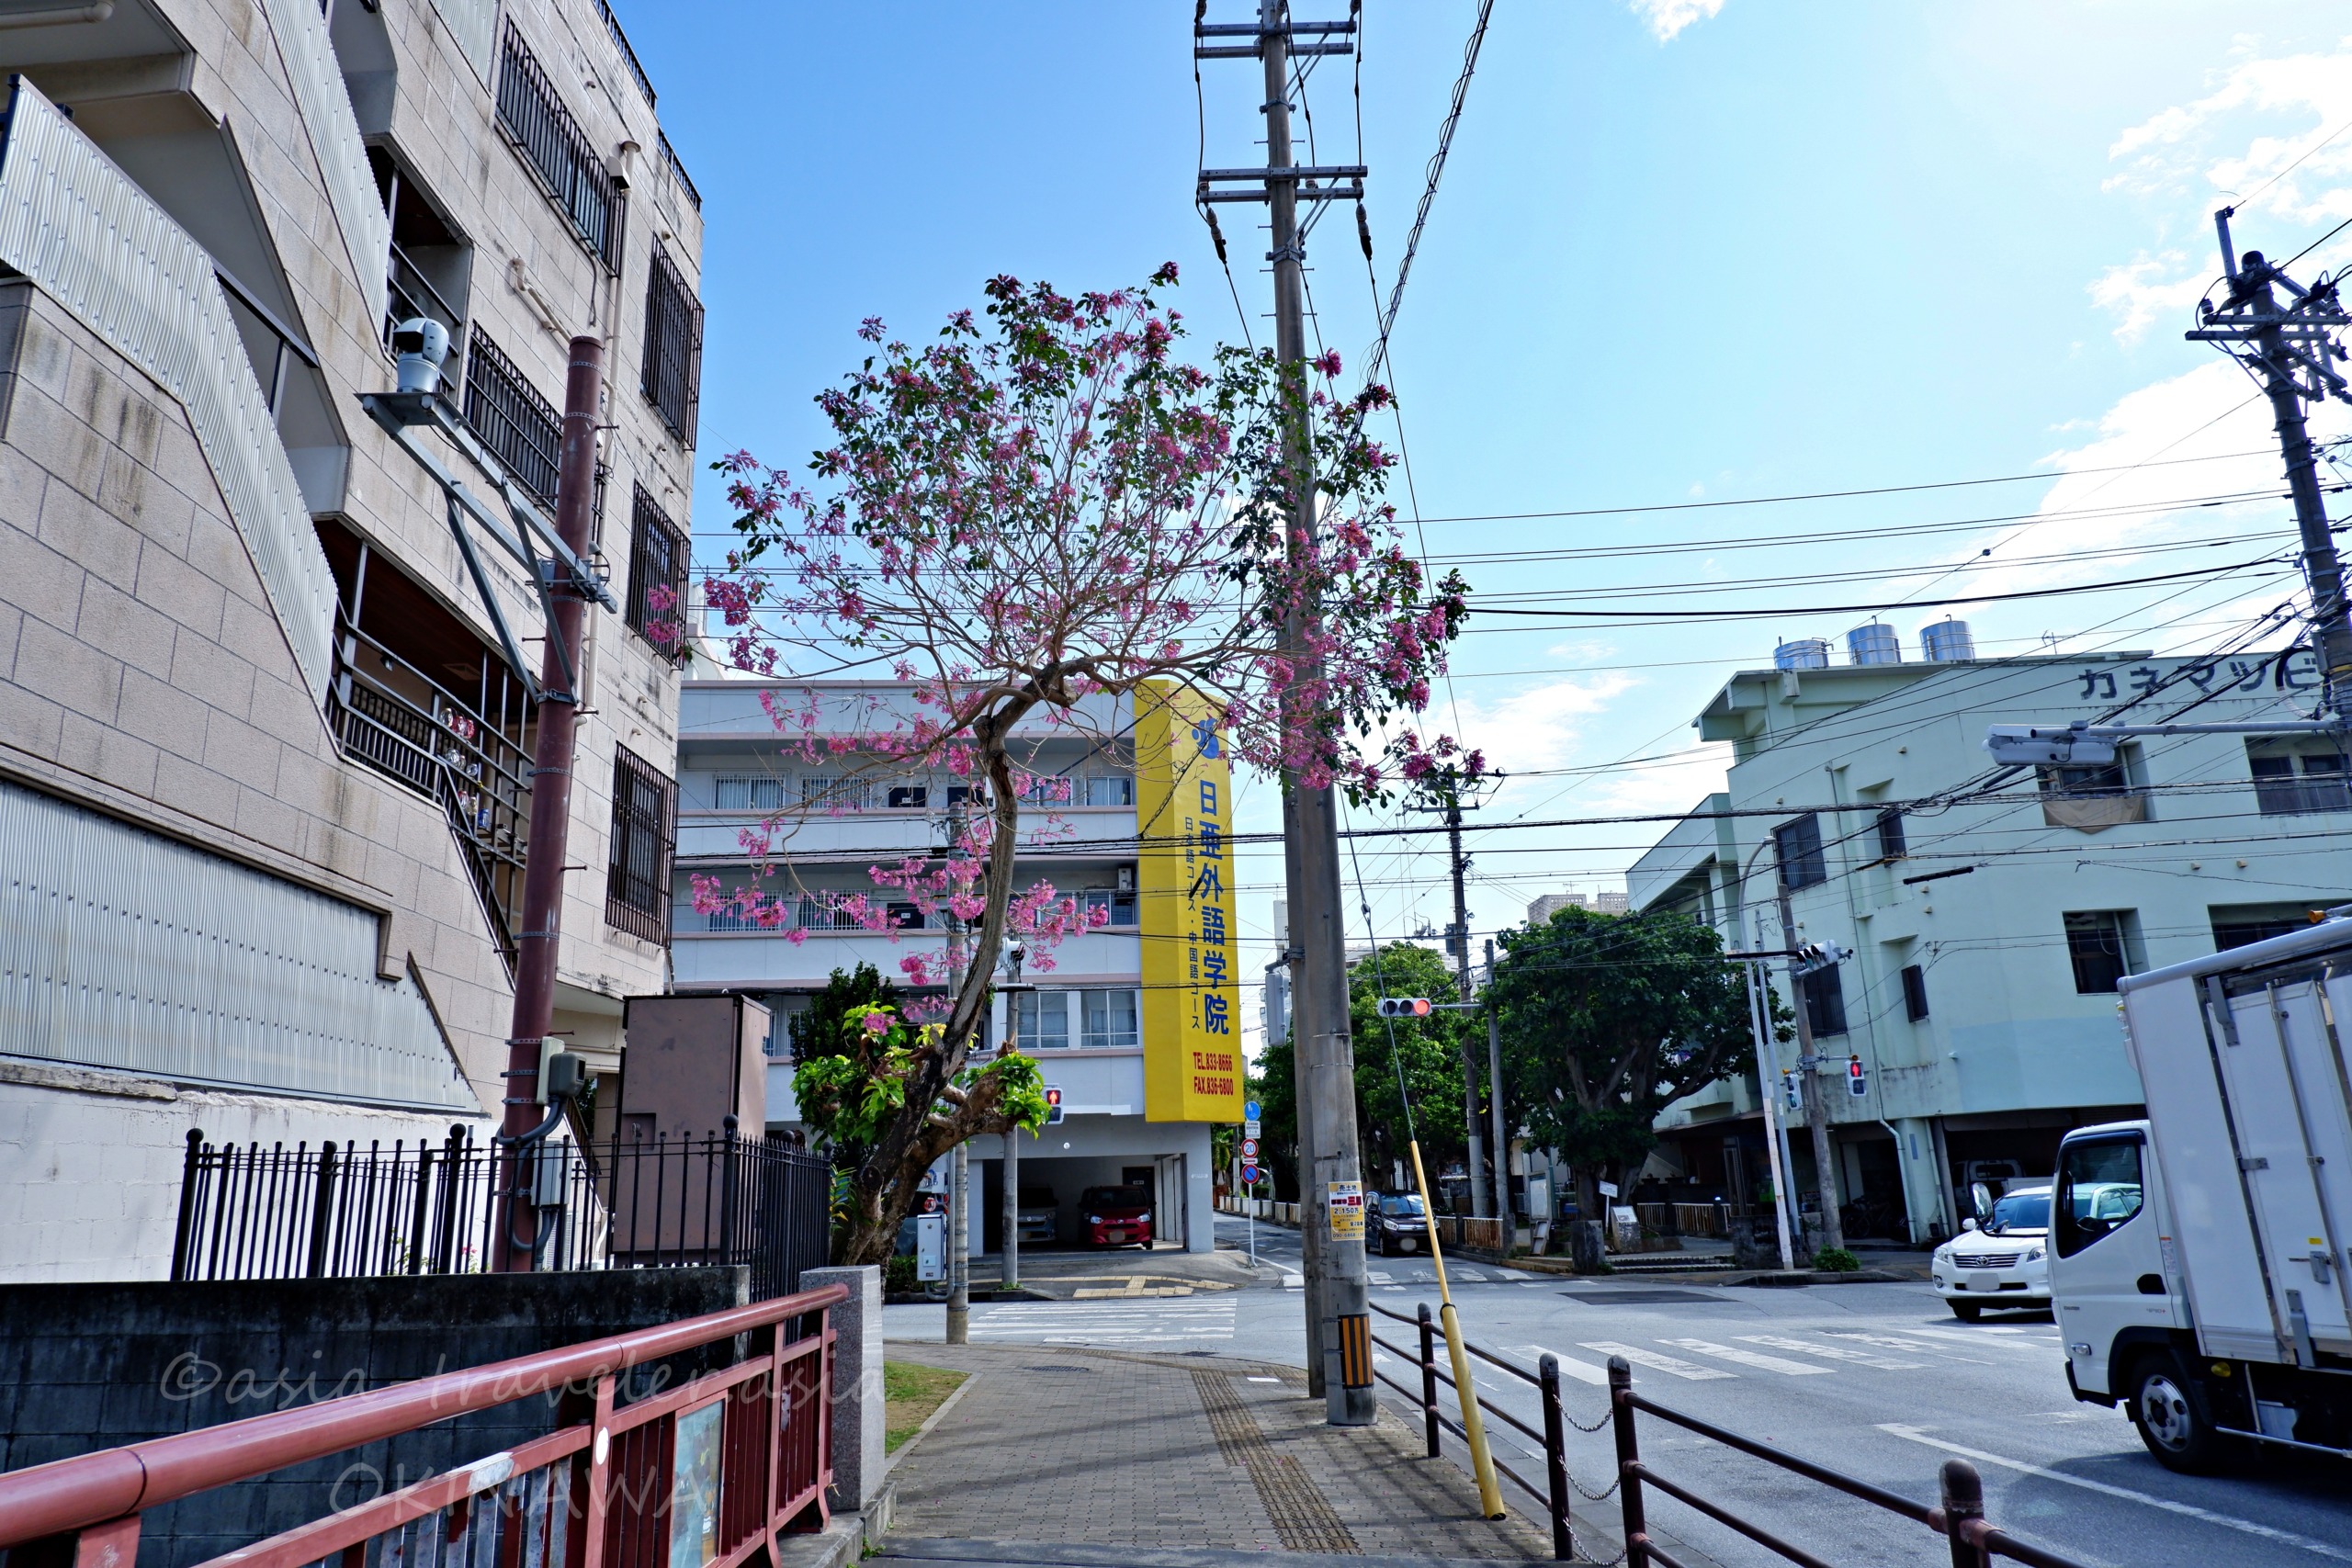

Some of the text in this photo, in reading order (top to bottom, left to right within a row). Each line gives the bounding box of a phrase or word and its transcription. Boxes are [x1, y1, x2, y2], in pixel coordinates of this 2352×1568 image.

[1198, 779, 1230, 1035] 日亜外語学院
[1193, 1076, 1234, 1096] FAX.836-6800
[1245, 1144, 1255, 1154] 20
[1339, 1184, 1357, 1192] 売土地
